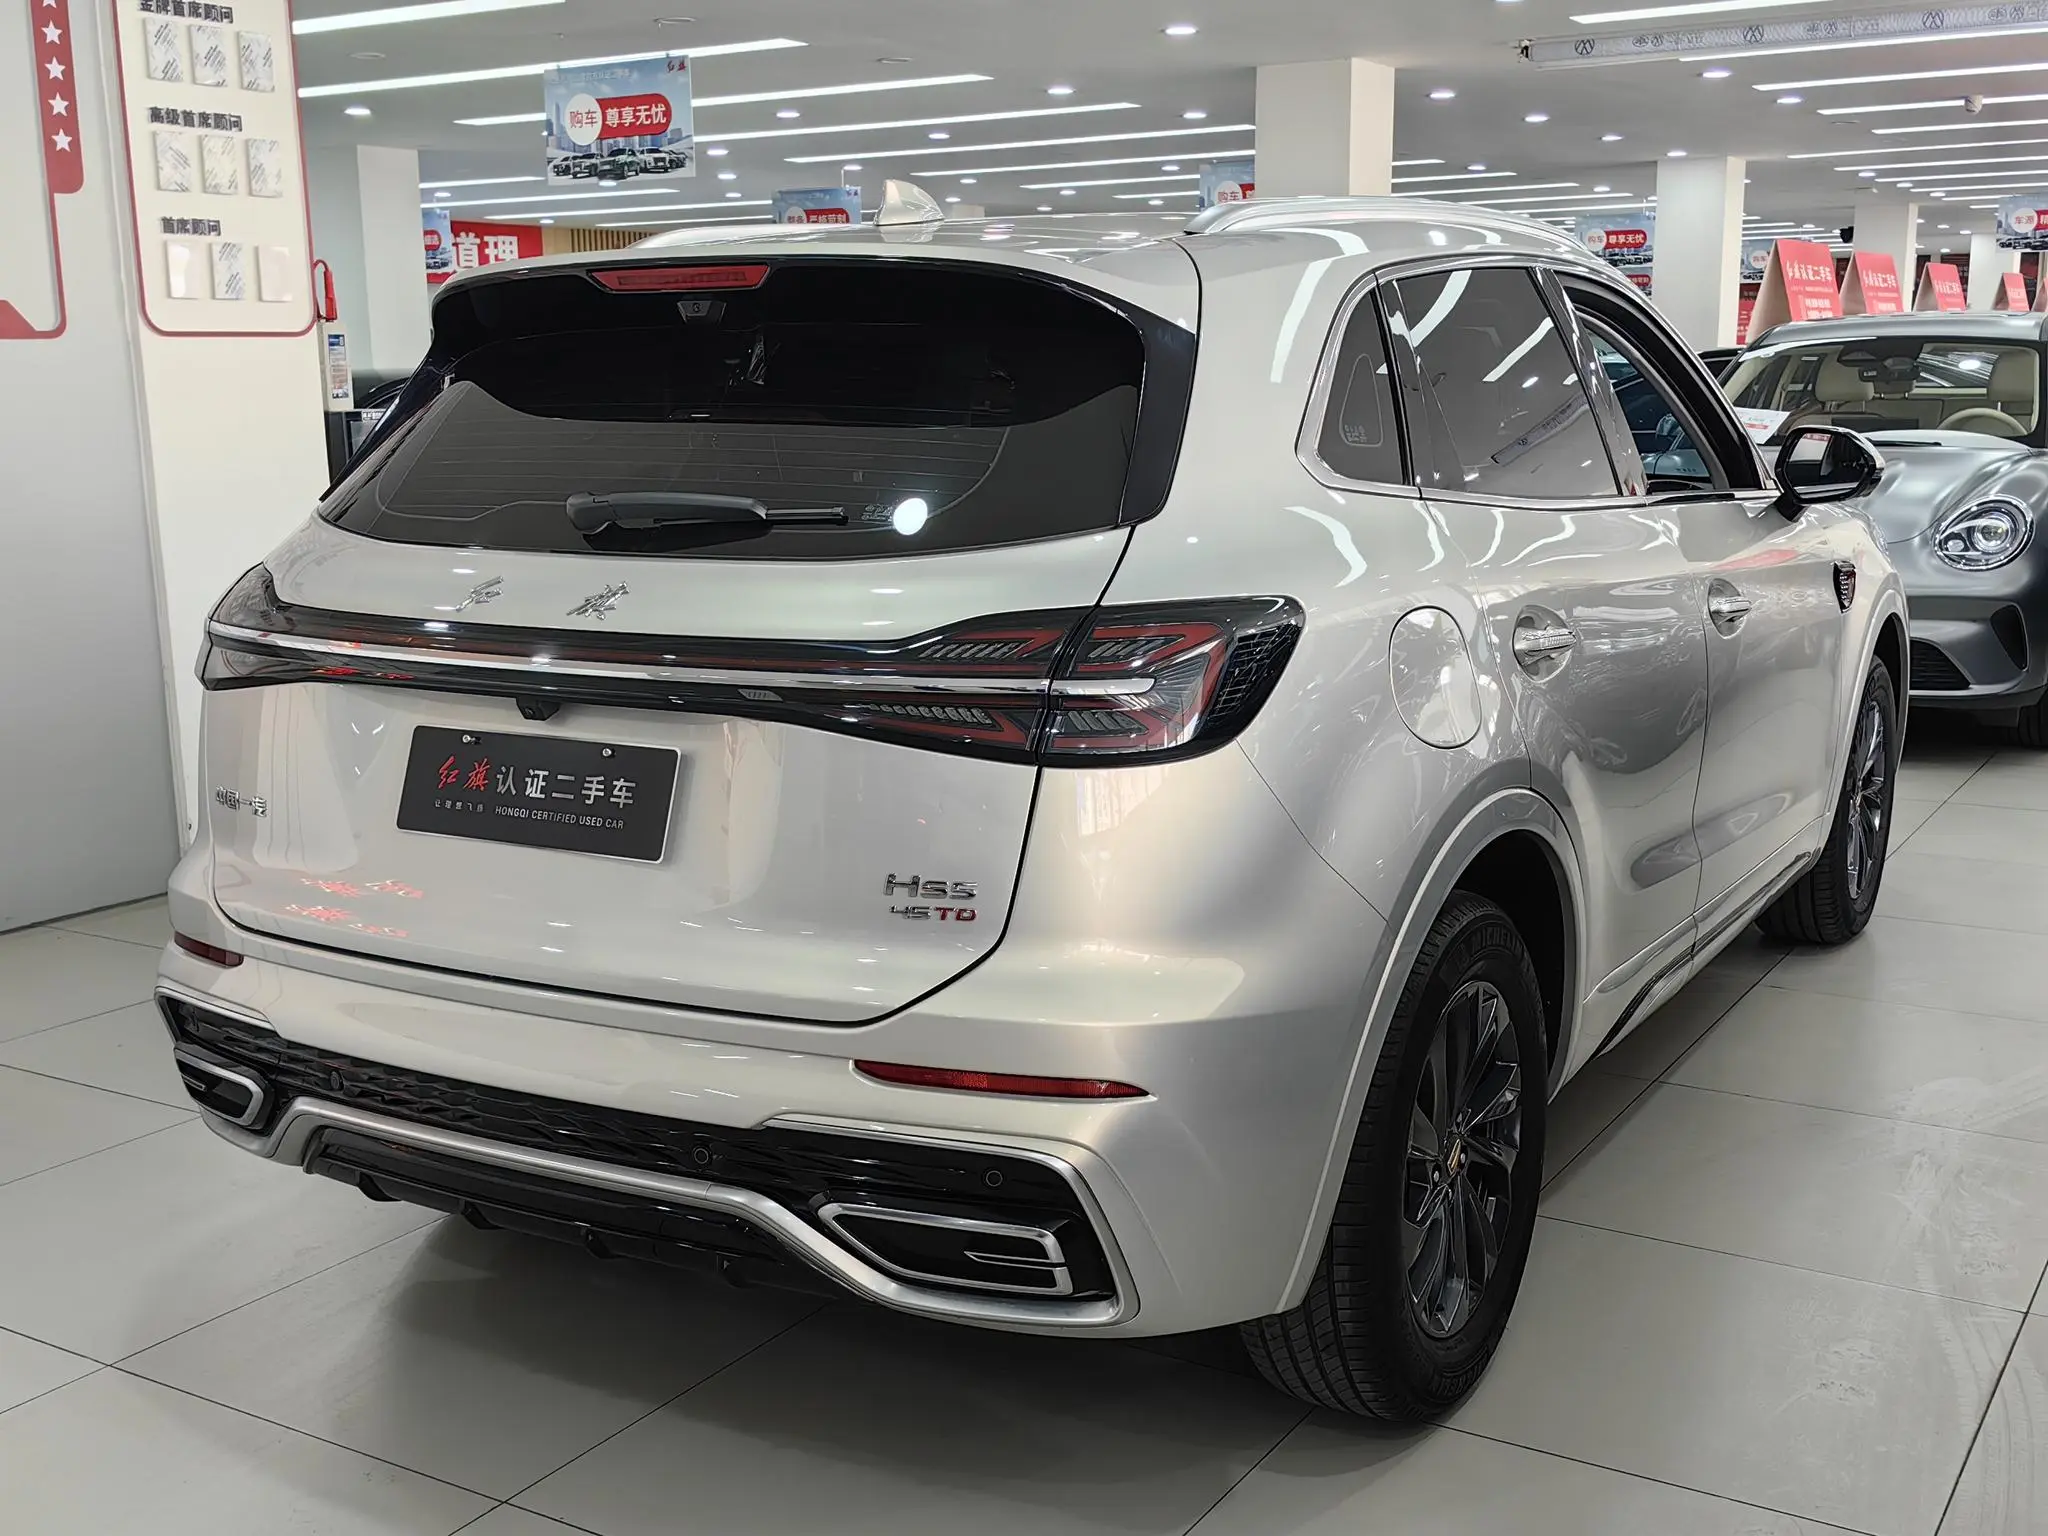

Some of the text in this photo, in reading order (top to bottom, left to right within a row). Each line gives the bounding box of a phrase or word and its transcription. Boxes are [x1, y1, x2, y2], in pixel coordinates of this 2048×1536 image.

[149, 106, 243, 132] 高级首席顾问
[569, 103, 667, 129] 购车 尊享无忧
[161, 217, 221, 236] 首席顾问
[1608, 230, 1644, 244] 尊享无忧
[437, 755, 637, 808] 红旗认证二手车
[495, 805, 529, 819] HONGQI
[531, 810, 577, 825] CERTIFIED
[579, 816, 603, 827] USED
[605, 818, 624, 829] CAR
